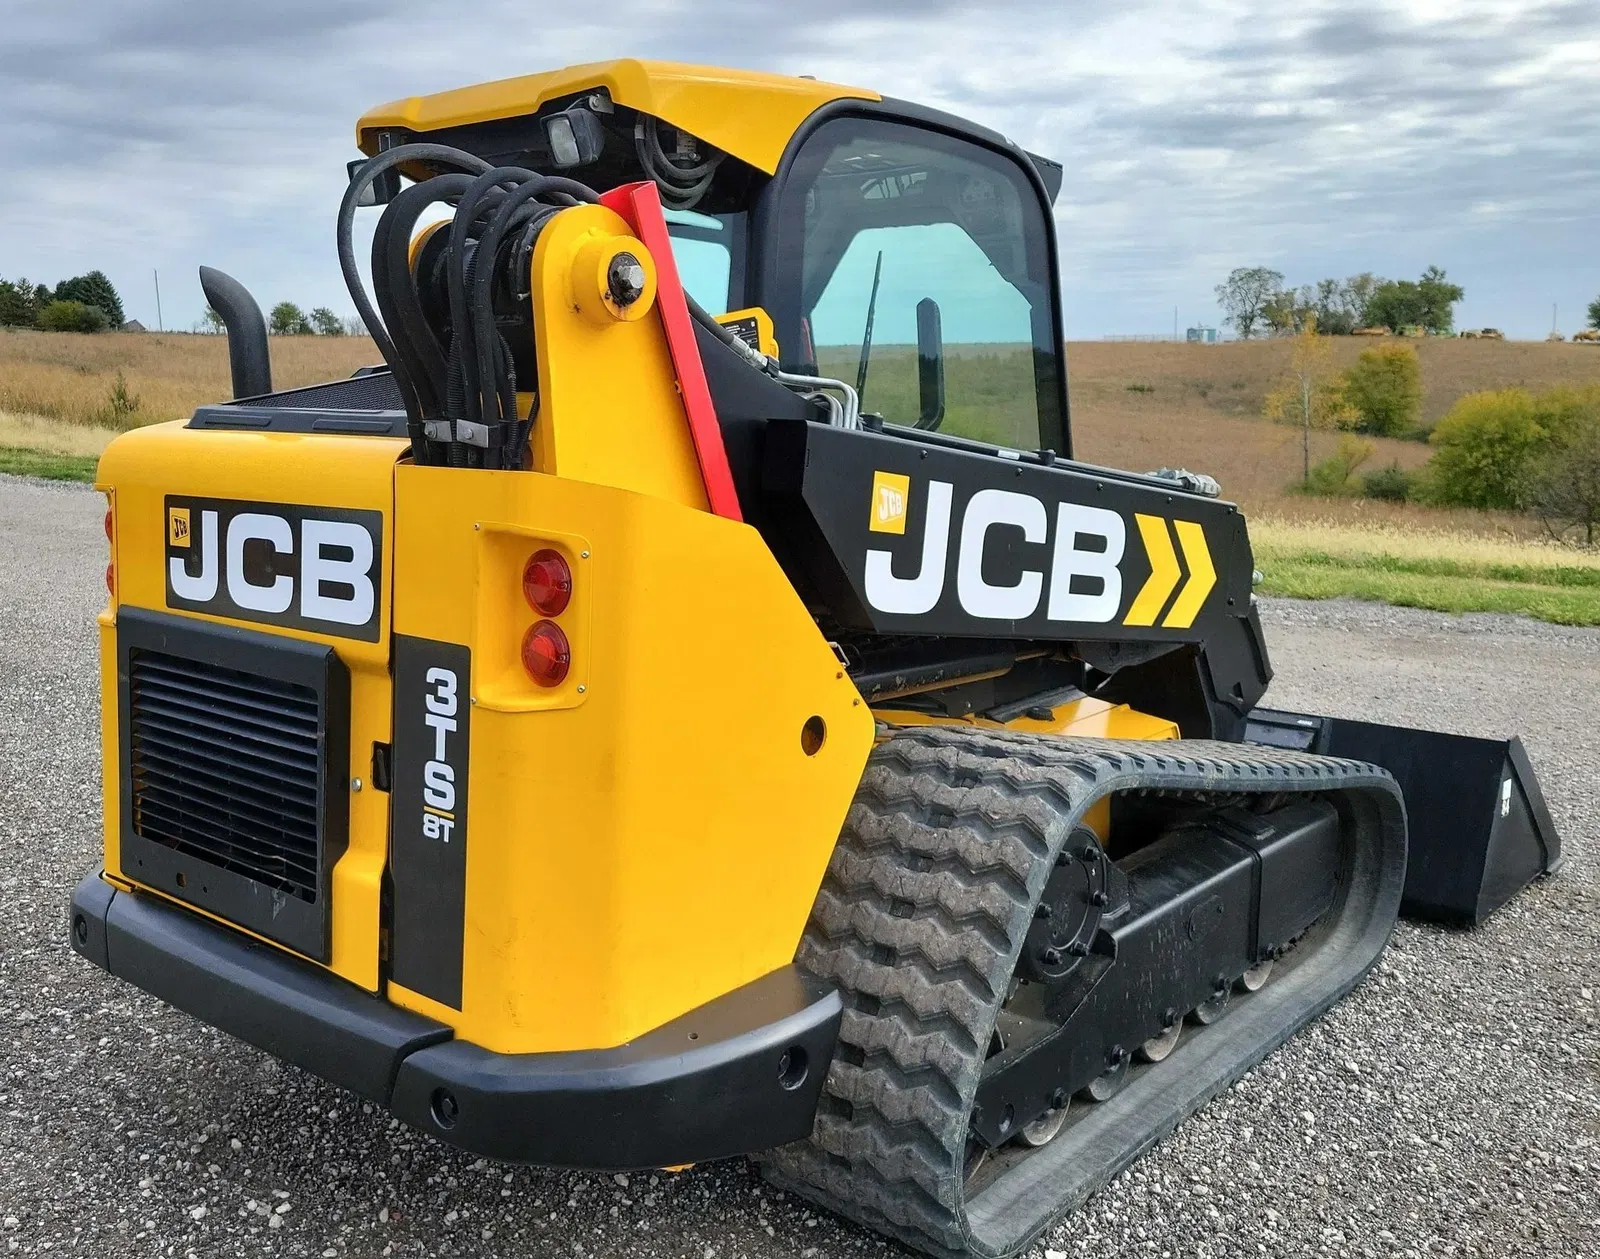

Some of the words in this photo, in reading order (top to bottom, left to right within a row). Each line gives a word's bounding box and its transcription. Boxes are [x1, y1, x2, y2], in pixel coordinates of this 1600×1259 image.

[879, 487, 902, 520] JCB
[174, 517, 188, 538] JCB
[864, 479, 1127, 623] JCB
[169, 510, 375, 626] JCB
[422, 813, 455, 843] 8T
